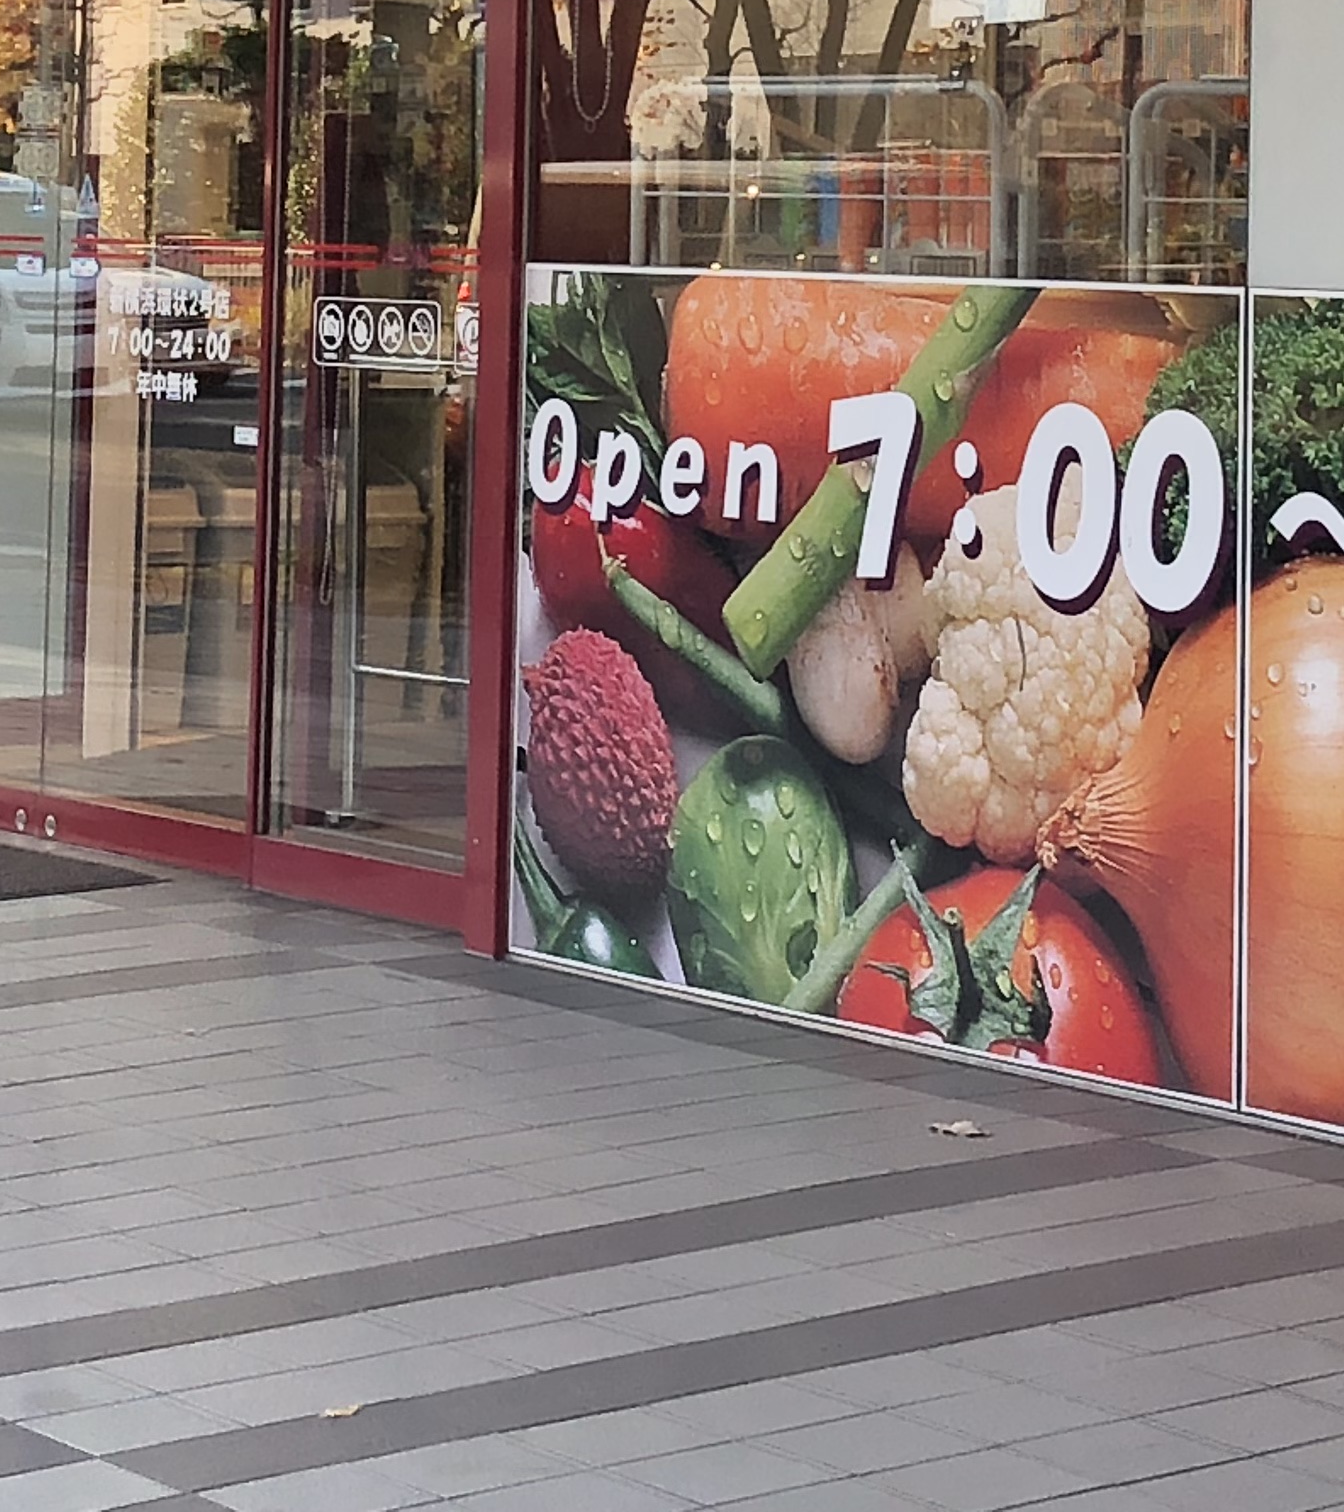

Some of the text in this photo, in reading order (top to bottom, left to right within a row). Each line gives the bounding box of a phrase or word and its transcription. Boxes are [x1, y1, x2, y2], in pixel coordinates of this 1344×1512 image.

[136, 369, 198, 402] 年中無休
[528, 397, 779, 524] Open
